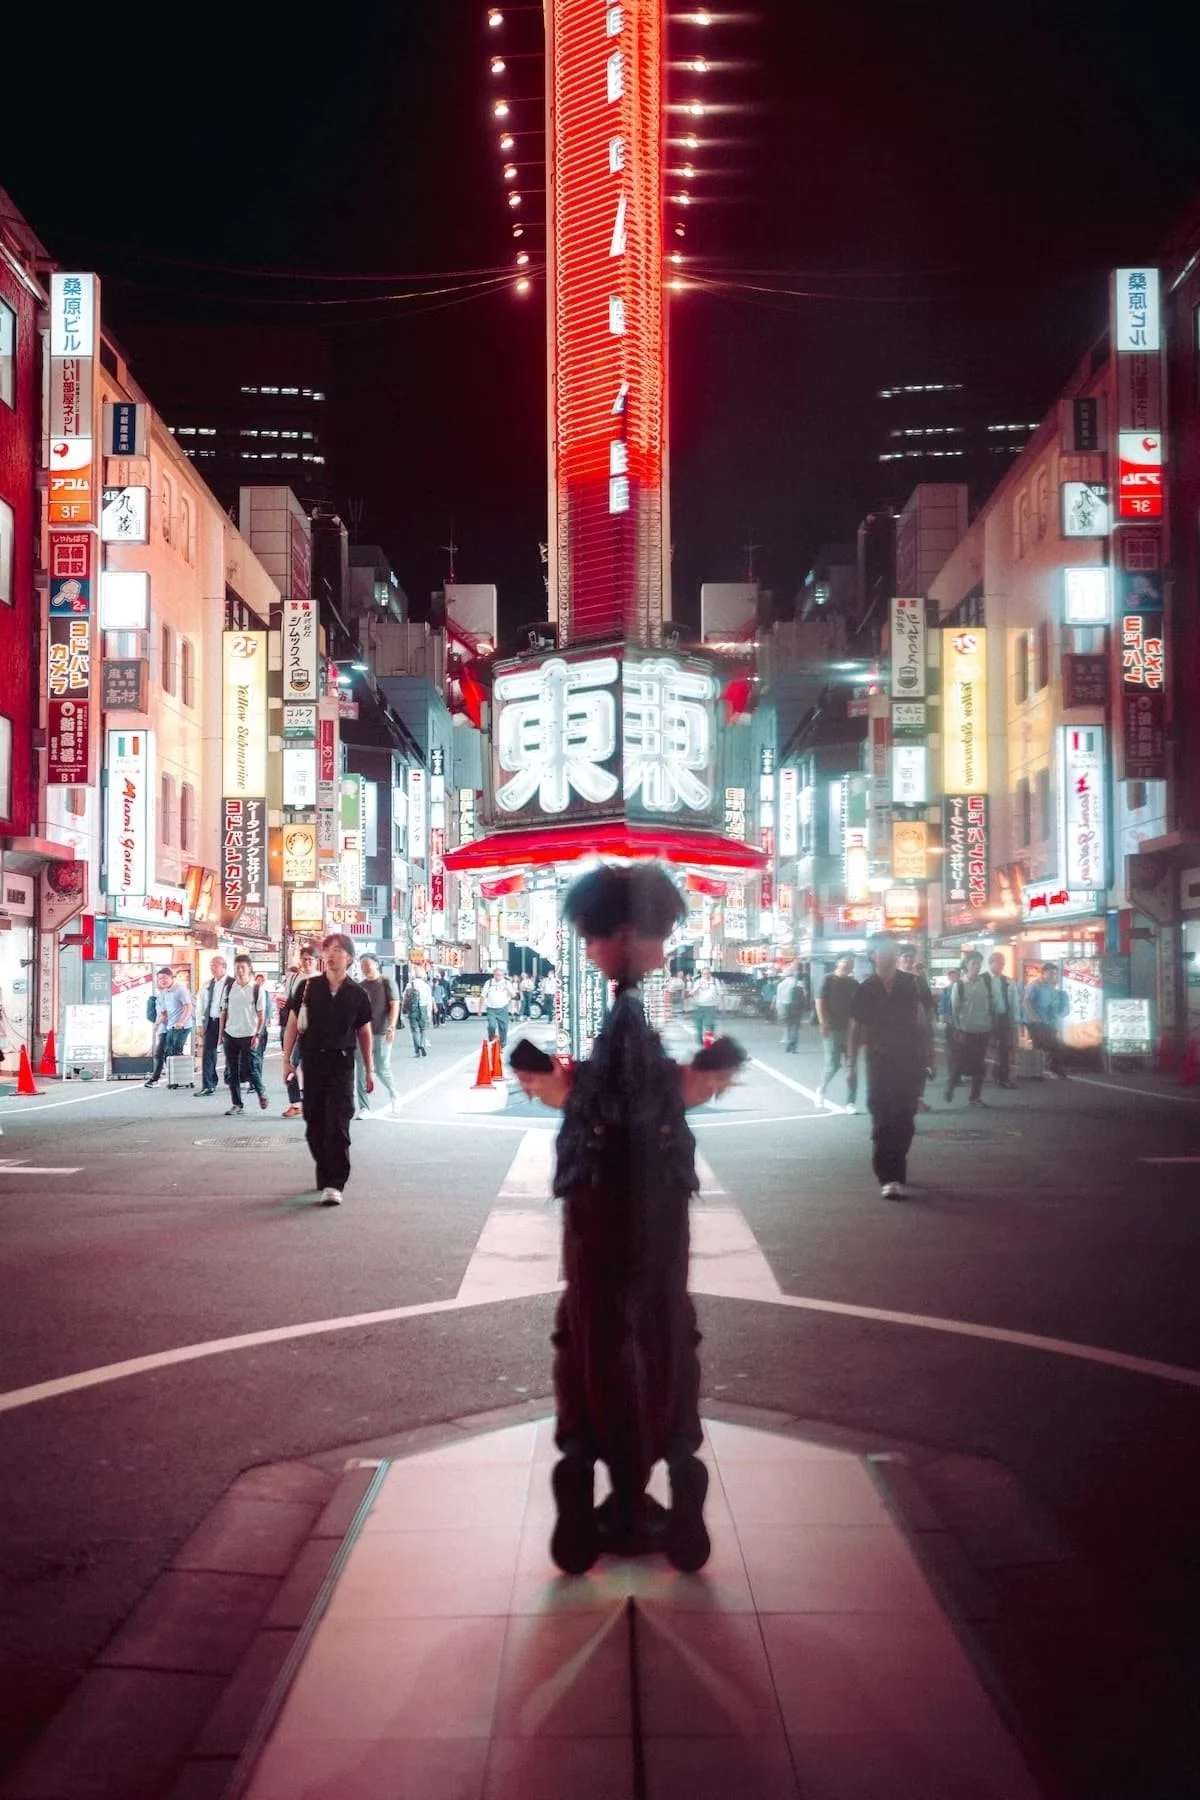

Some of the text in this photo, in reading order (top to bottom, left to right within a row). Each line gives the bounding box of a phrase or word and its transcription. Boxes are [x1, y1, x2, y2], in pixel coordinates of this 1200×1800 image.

[63, 277, 81, 351] 桑原ビル
[63, 359, 75, 436] いい部屋ネット
[51, 478, 89, 490] アコム
[60, 505, 81, 519] 3F
[73, 600, 86, 611] 2F
[70, 621, 89, 690] ヨドバシ
[231, 636, 258, 659] 2F
[288, 616, 302, 667] シムックス
[50, 643, 69, 695] カメラ
[237, 684, 249, 790] Yellow Submarine
[286, 709, 313, 718] ゴルフ
[225, 800, 243, 911] ヨドバシカメラ
